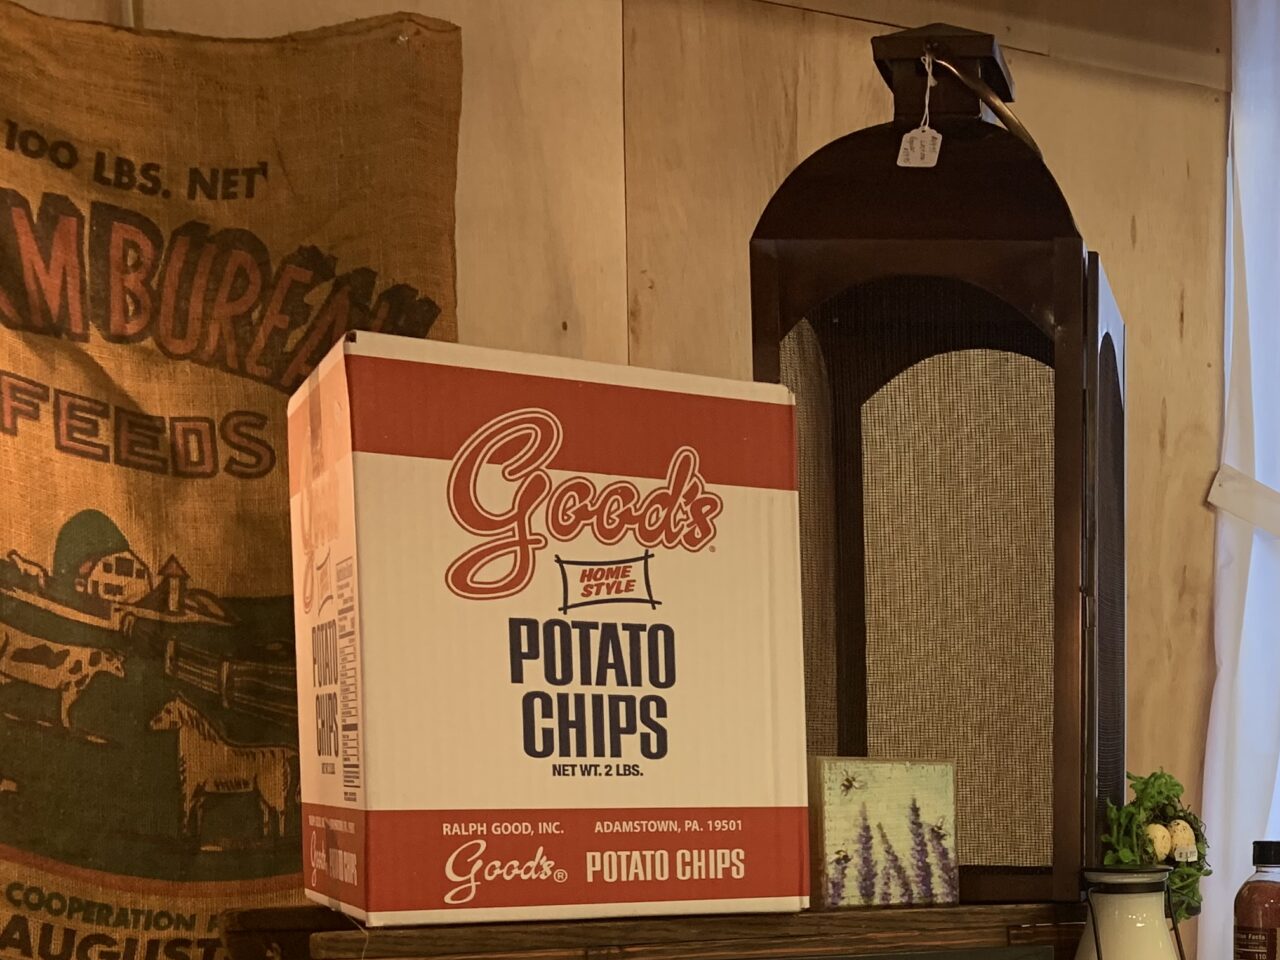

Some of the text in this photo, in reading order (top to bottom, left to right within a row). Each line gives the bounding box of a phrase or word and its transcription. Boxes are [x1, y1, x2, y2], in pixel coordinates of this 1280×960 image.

[3, 119, 78, 170] 100
[93, 152, 171, 198] LBS.
[0, 370, 276, 480] FEEDS
[445, 408, 723, 601] Good's
[579, 566, 632, 583] HOME
[581, 580, 636, 597] STYLE
[508, 617, 676, 689] POTATO
[522, 691, 668, 760] CHIPS
[552, 764, 644, 777] NET WT. 2 LBS.
[443, 822, 565, 836] RALPH GOOD, INC.
[594, 820, 743, 834] ADAMSTOWN, PA. 19501
[444, 839, 556, 904] Good's
[586, 848, 745, 882] POTATO CHIPS
[5, 882, 196, 933] COOPERATION
